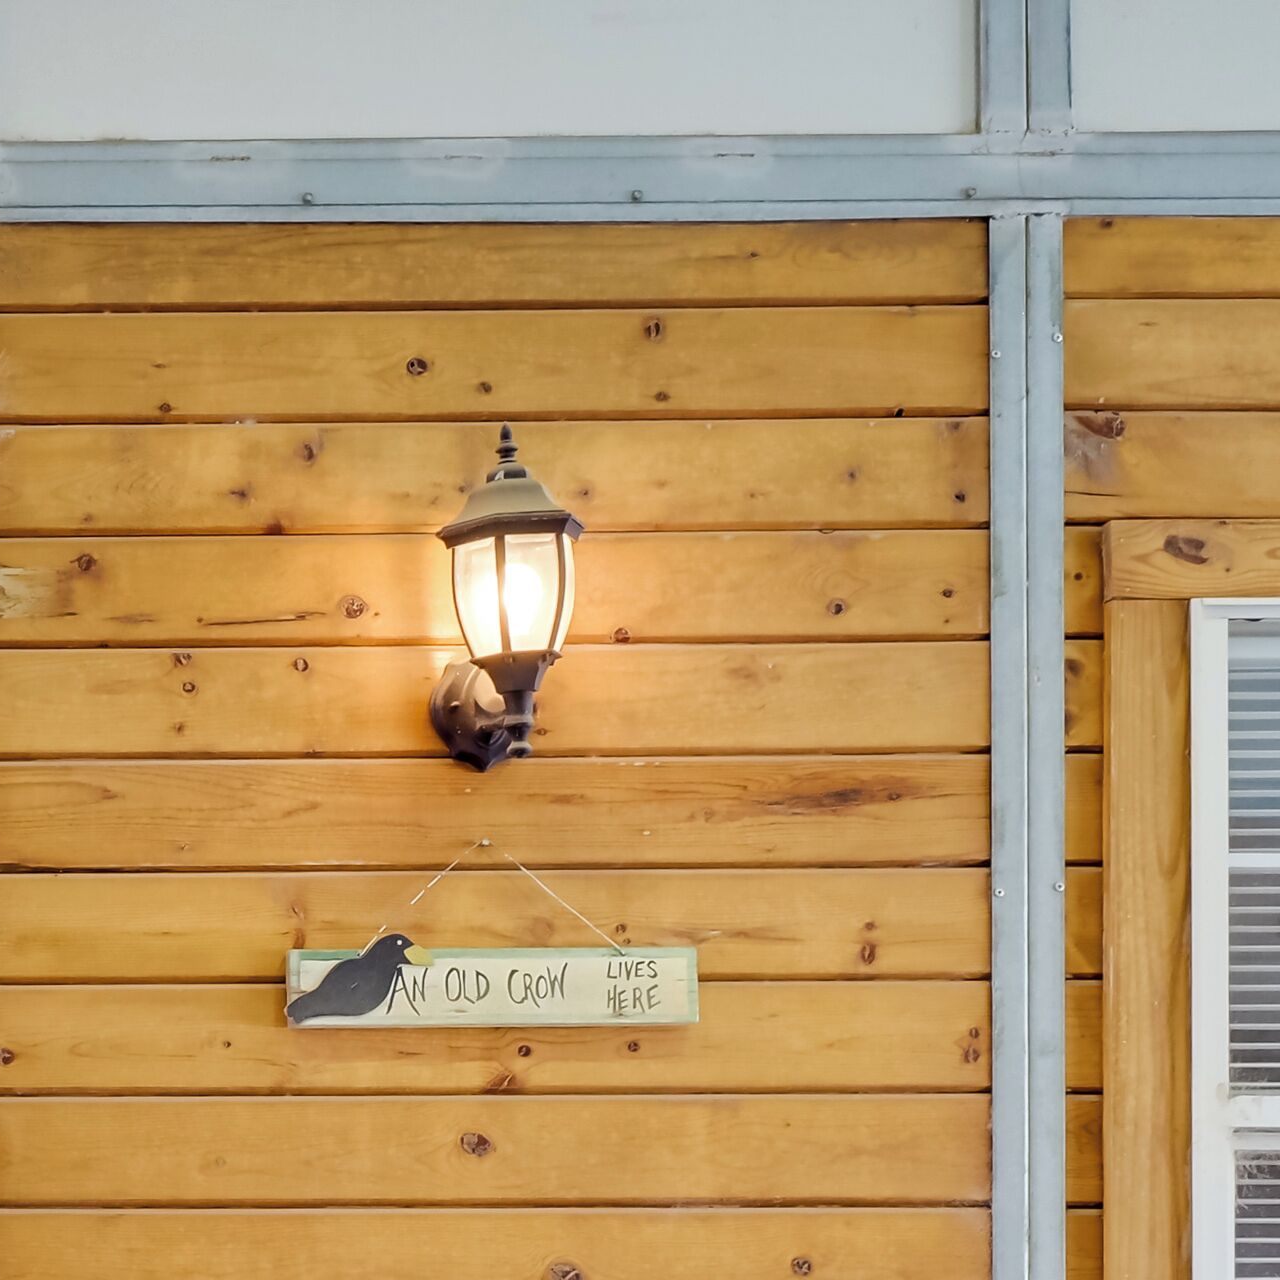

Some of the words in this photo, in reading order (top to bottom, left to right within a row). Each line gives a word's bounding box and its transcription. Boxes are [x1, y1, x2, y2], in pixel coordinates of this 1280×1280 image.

[607, 960, 659, 981] LIVES
[386, 965, 428, 1016] AN
[445, 967, 490, 1004] OLD
[507, 962, 568, 1009] CROW
[606, 984, 661, 1013] HERE
